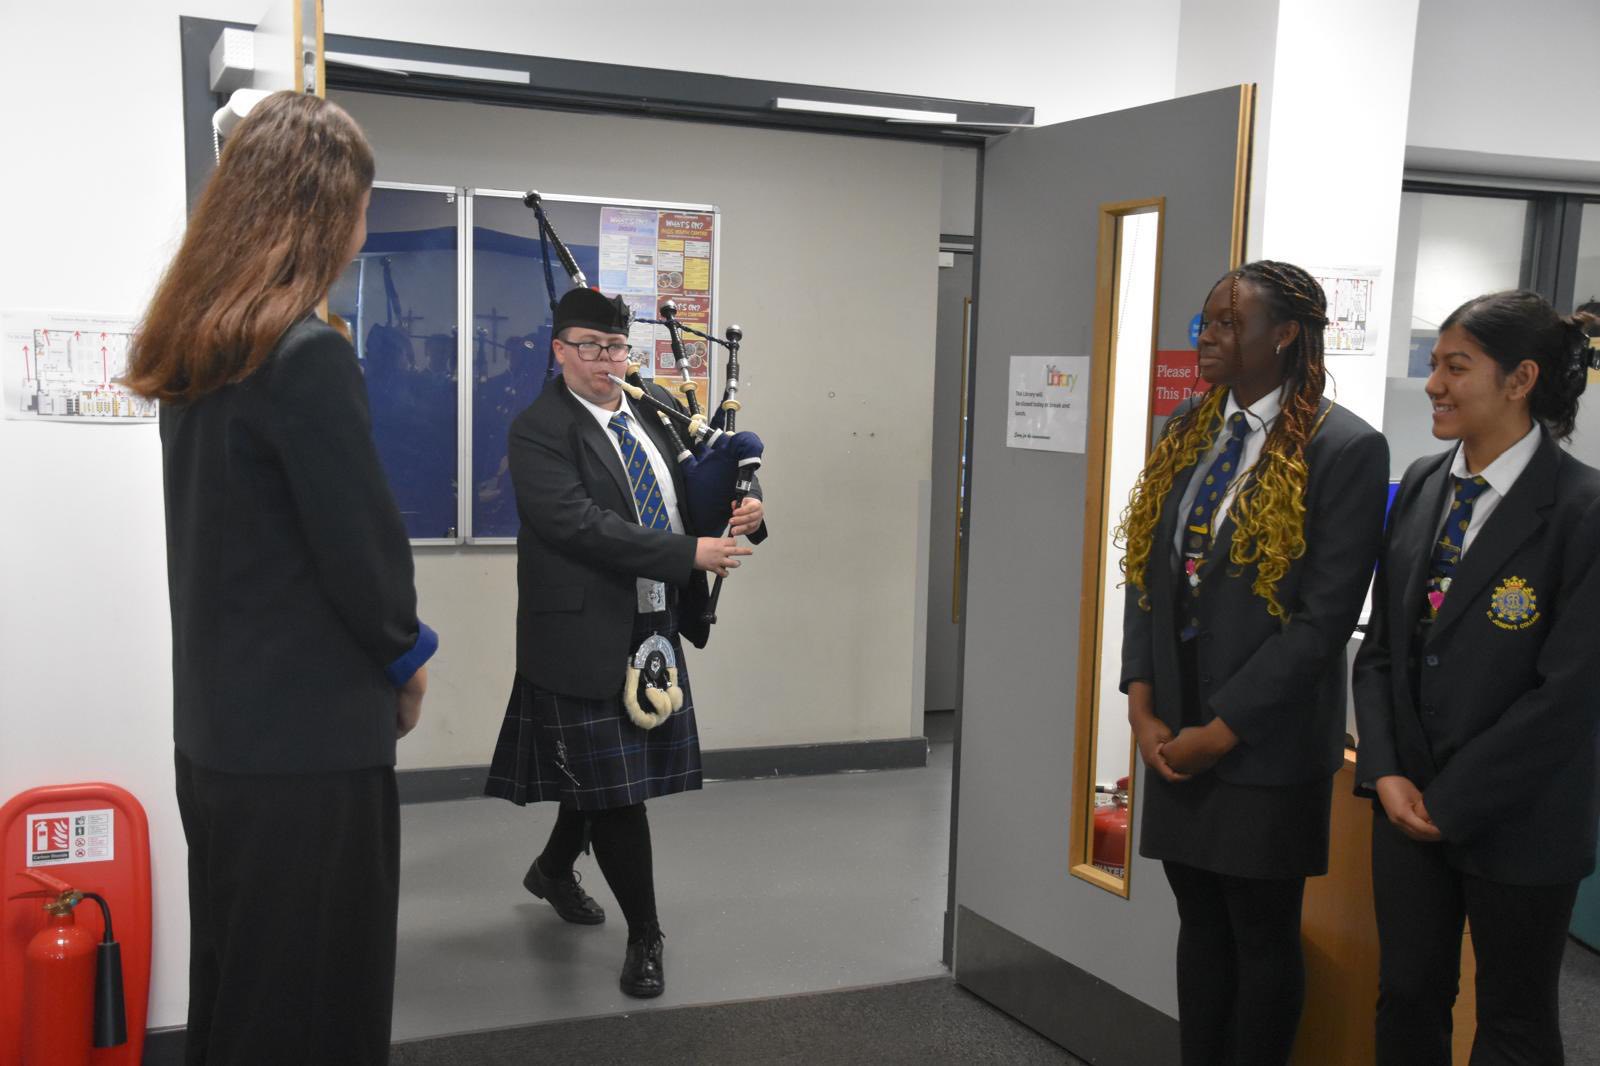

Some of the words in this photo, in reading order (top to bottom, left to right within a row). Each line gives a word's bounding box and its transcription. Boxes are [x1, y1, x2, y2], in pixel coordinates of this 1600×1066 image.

[665, 220, 690, 229] WHAT'S
[691, 221, 704, 230] ON?
[1157, 364, 1191, 378] Please
[1156, 386, 1180, 400] This
